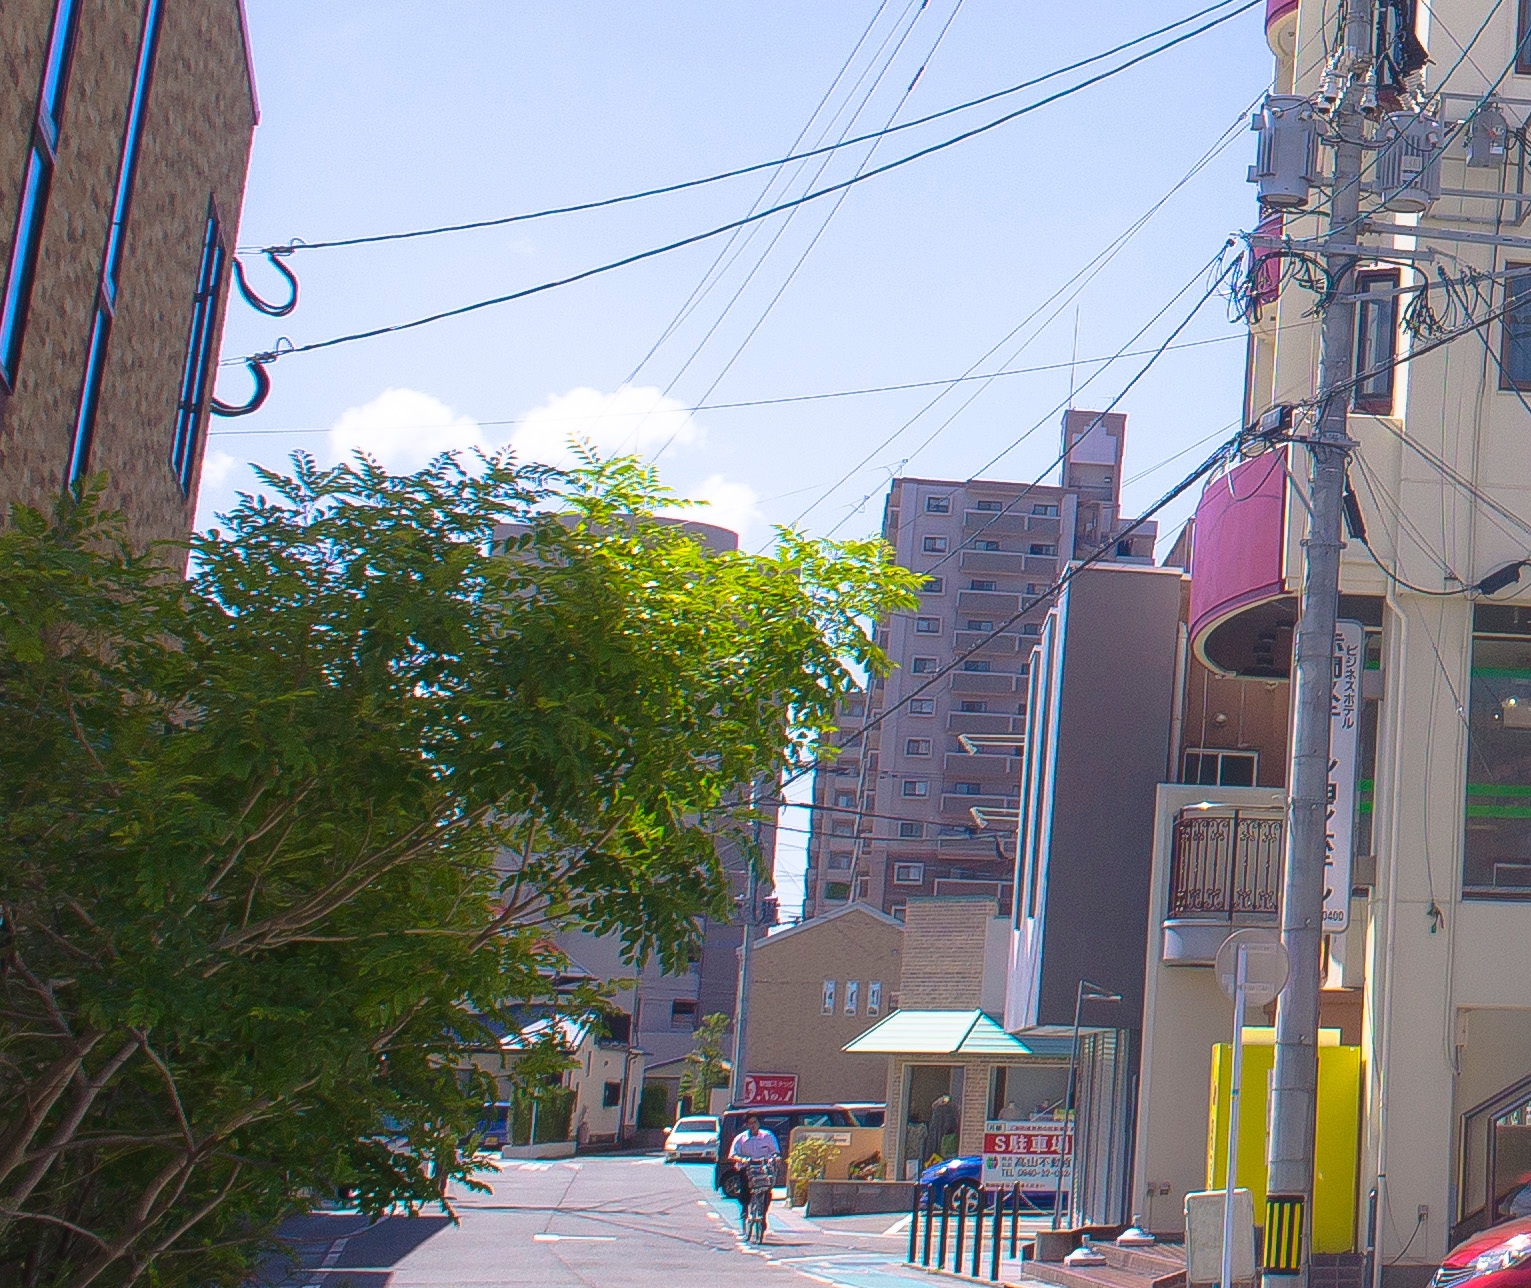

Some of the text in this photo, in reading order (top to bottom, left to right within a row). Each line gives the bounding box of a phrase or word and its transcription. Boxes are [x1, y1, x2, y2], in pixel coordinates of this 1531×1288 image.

[1342, 644, 1358, 730] ビジネスホテル
[1001, 1168, 1014, 1177] TEL
